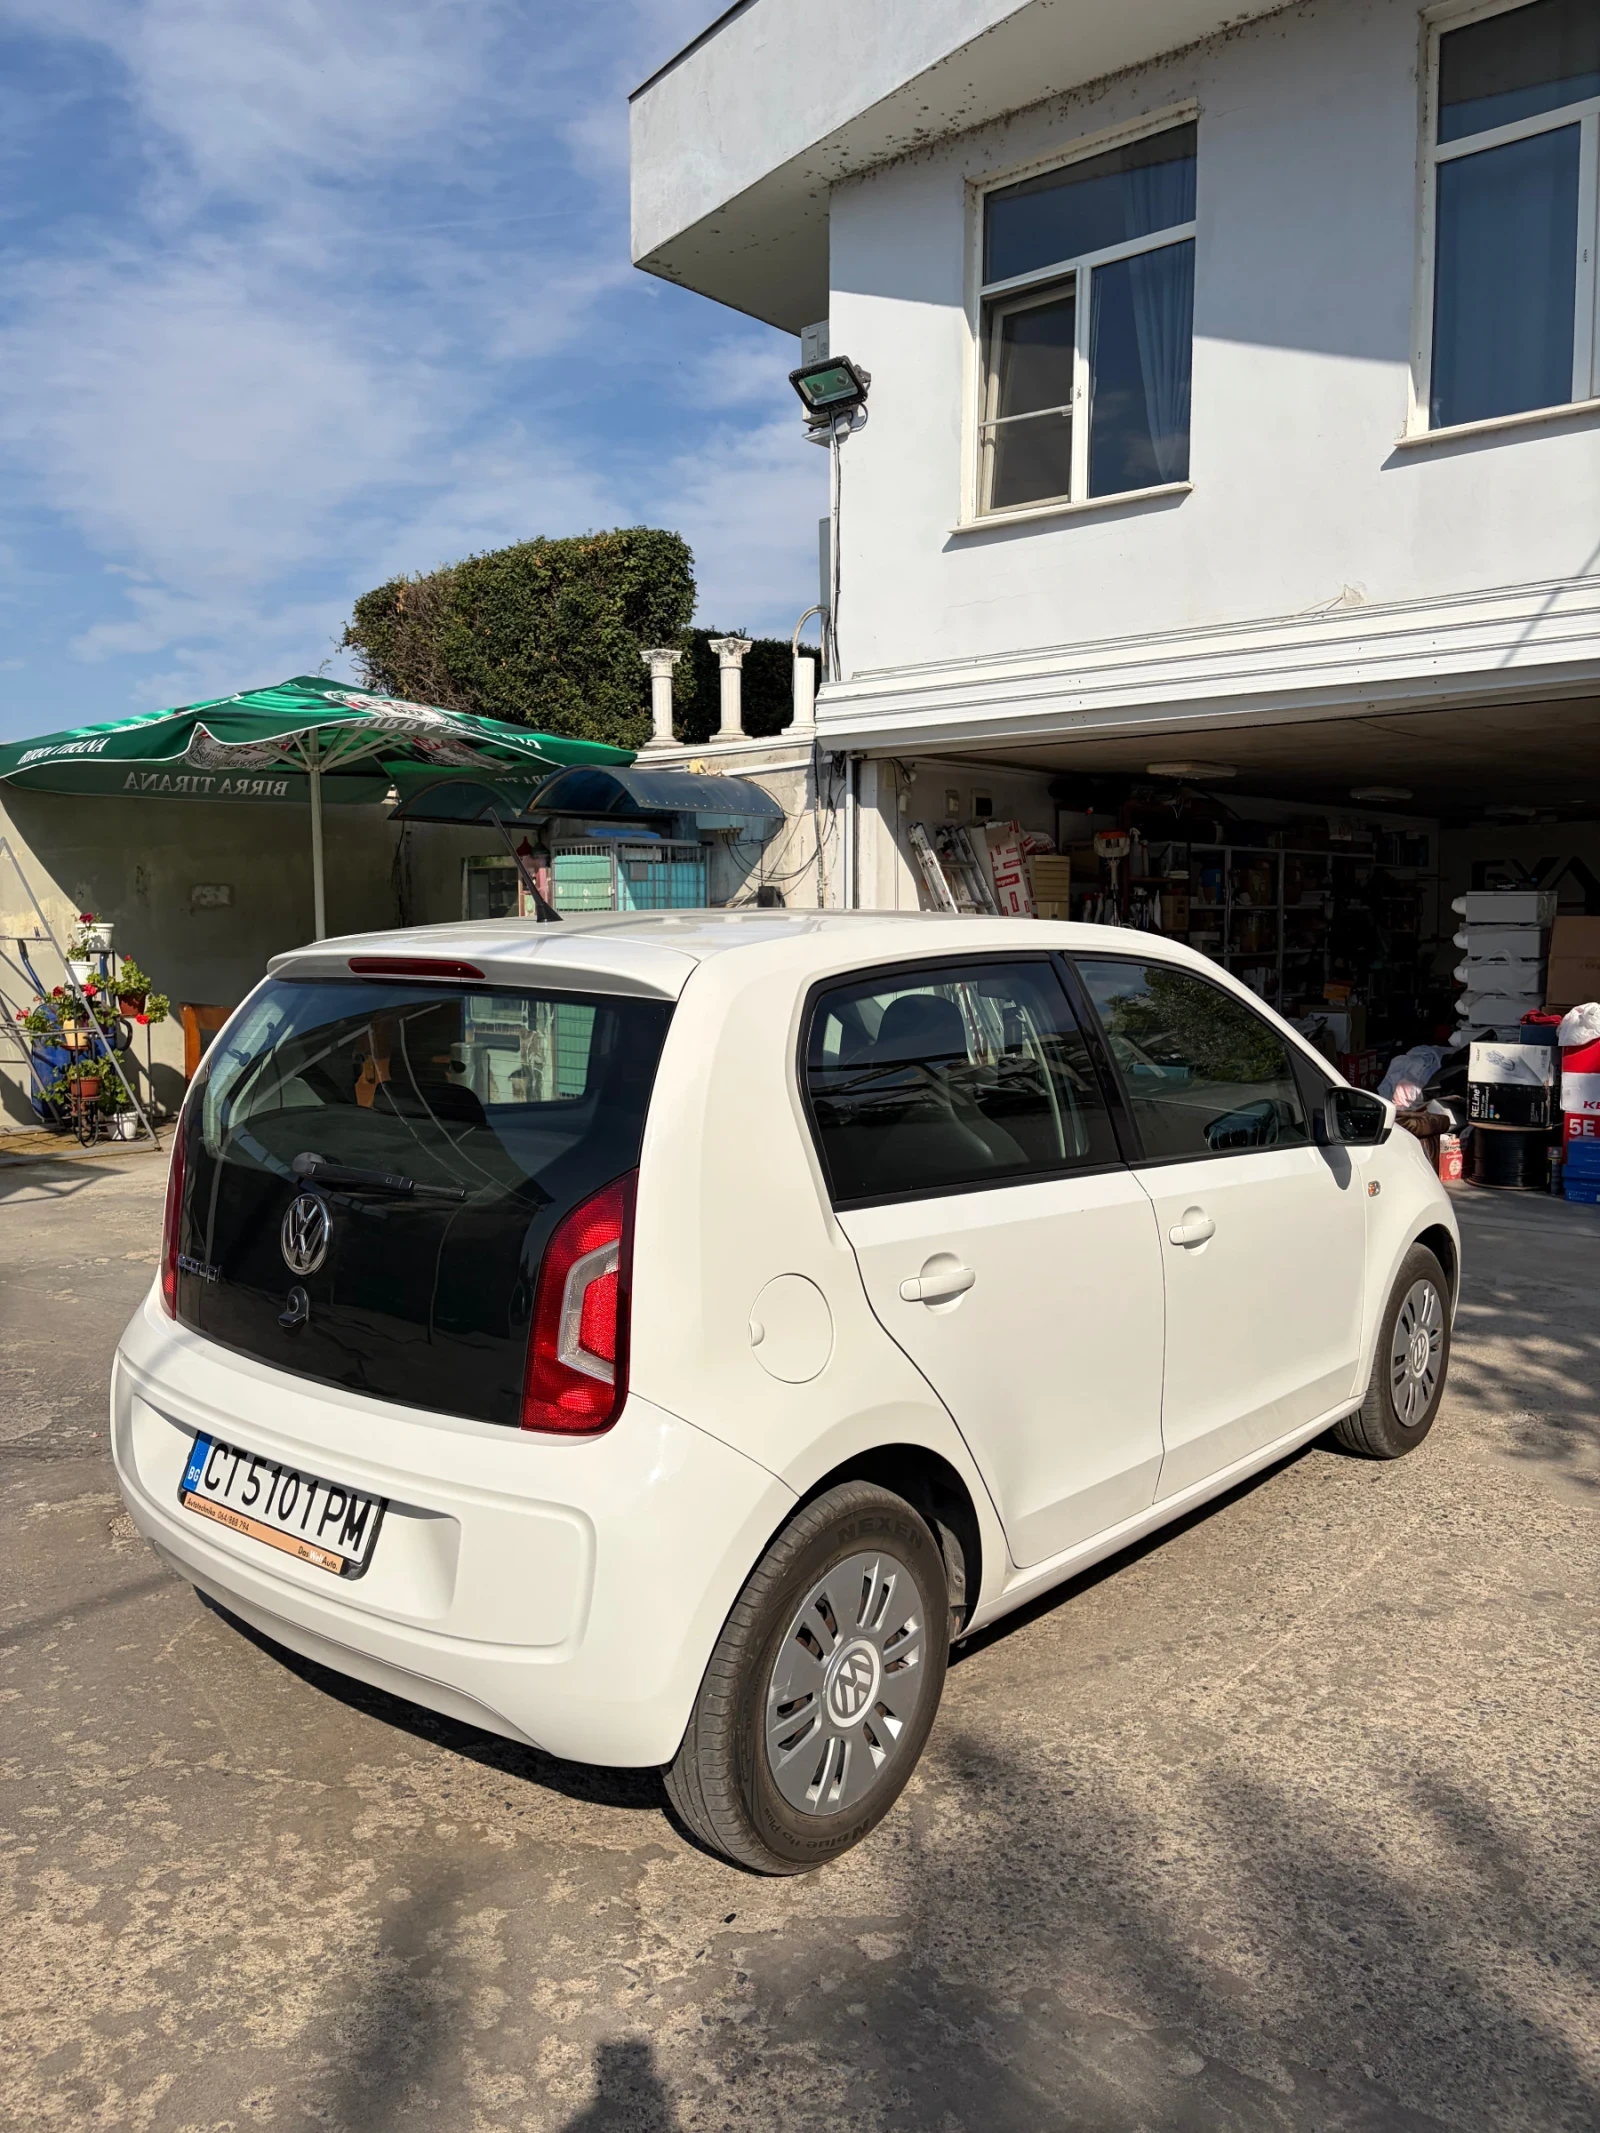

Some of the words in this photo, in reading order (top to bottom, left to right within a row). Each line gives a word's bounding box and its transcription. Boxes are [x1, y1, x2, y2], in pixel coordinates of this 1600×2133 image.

[1568, 1118, 1595, 1136] 5E
[187, 1466, 201, 1483] BG
[239, 1520, 250, 1532] 794
[837, 1516, 923, 1550] NEXEN
[298, 1545, 309, 1558] Das
